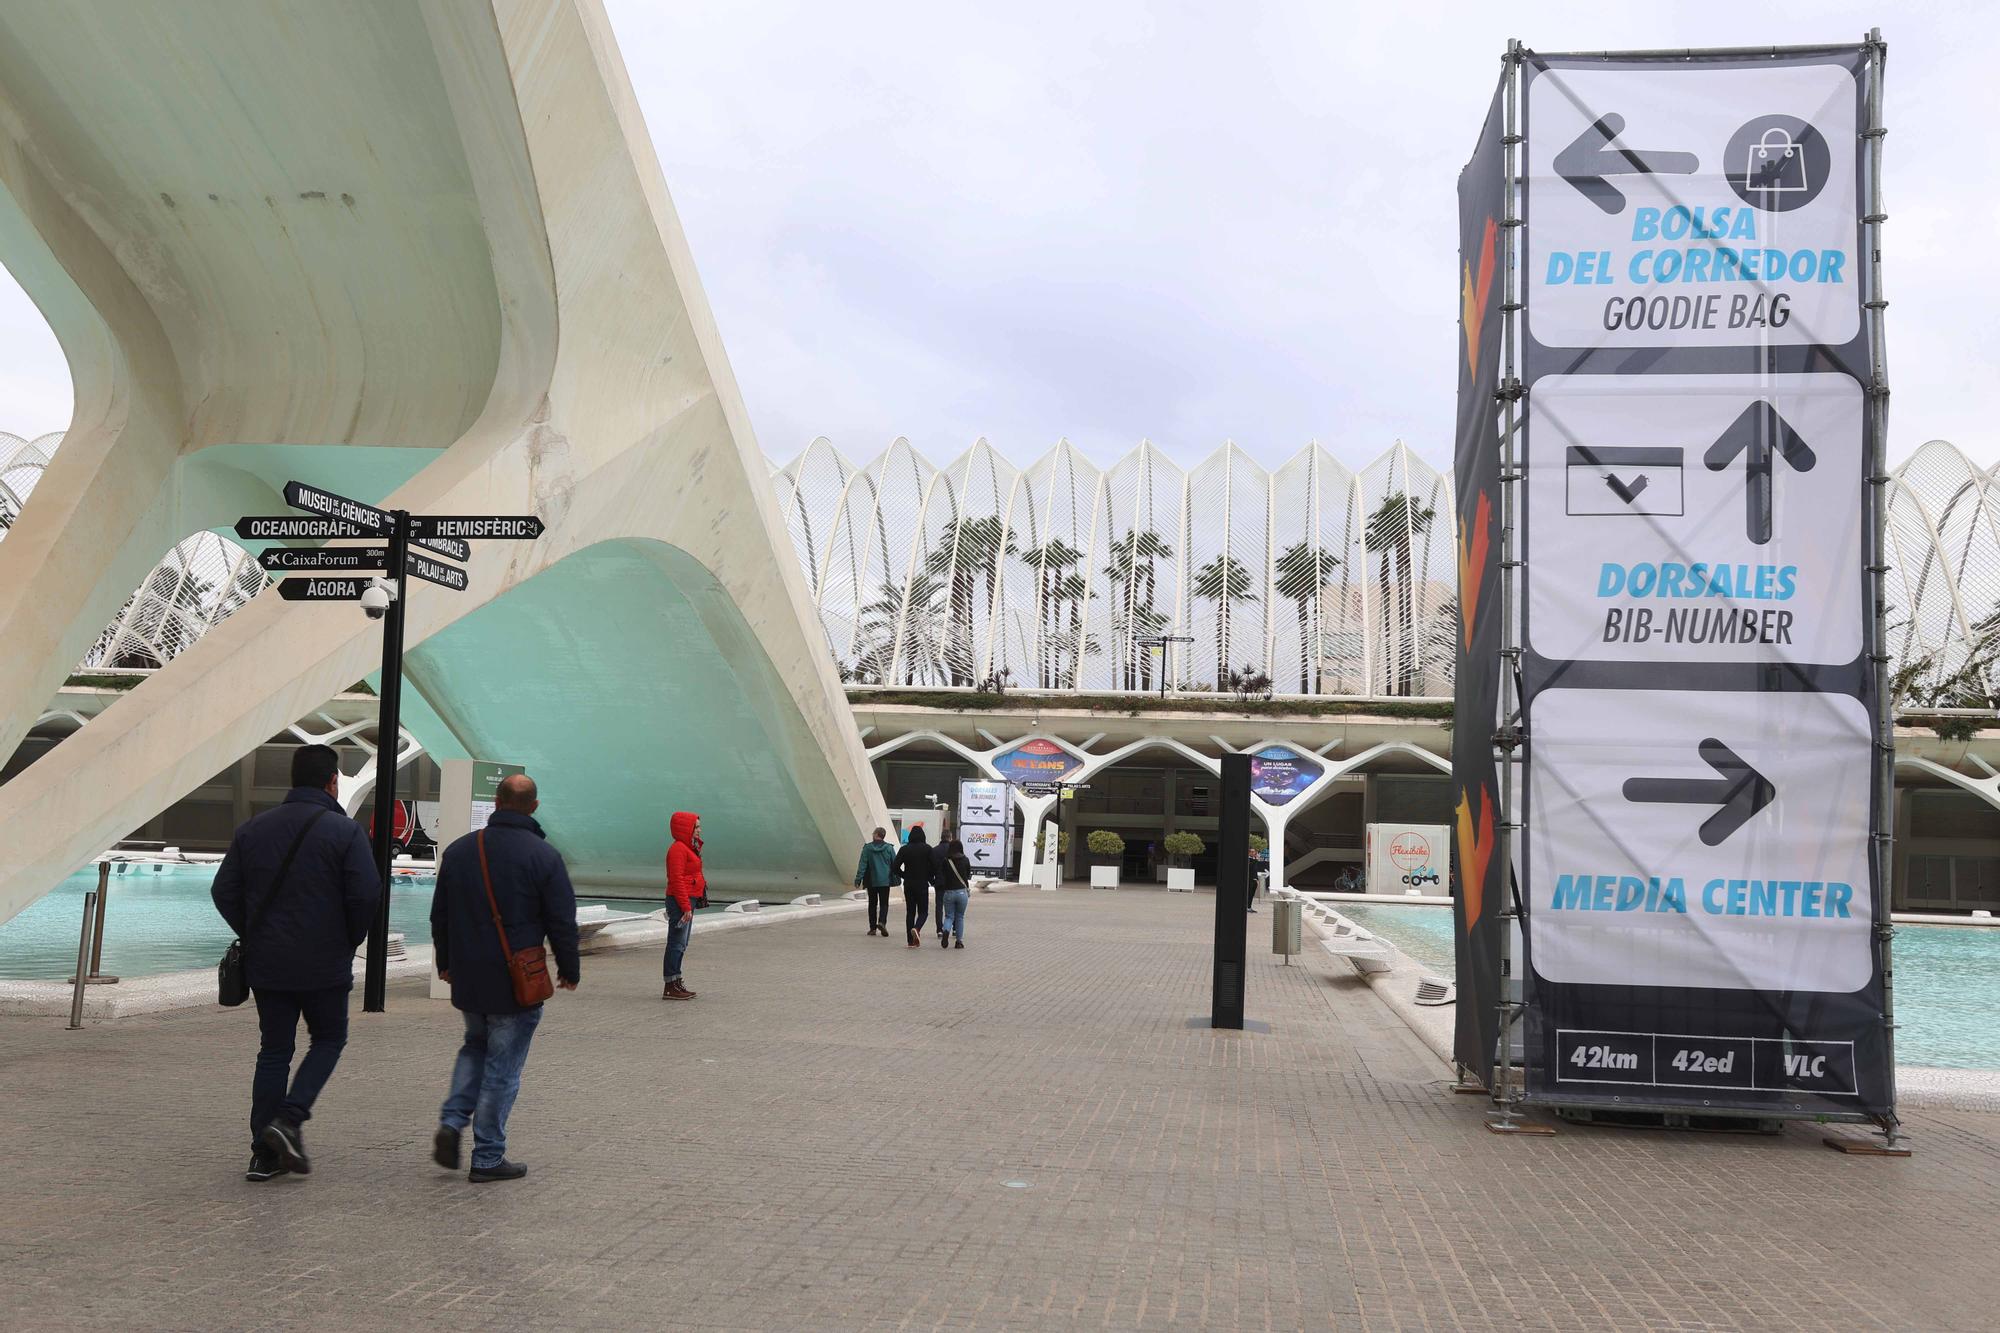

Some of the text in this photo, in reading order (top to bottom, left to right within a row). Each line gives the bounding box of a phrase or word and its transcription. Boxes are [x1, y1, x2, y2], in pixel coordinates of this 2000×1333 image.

[1631, 206, 1756, 241] BOLSA
[1545, 249, 1846, 285] DEL CORREDOR
[1603, 293, 1791, 330] GOODIE BAG
[299, 488, 332, 513] MUSEU
[341, 502, 380, 528] CIÈNCIES
[437, 518, 526, 535] HEMISFÈRIC
[282, 549, 384, 565] CaixaForum 300m
[306, 578, 357, 596] ÀGORA
[417, 560, 439, 579] PALAU
[446, 569, 463, 587] ARTS
[1597, 563, 1798, 600] DORSALES
[1602, 608, 1793, 645] BIB-NUMBER
[1551, 875, 1854, 919] MEDIA CENTER
[1570, 1045, 1638, 1070] 42km
[1672, 1049, 1735, 1074] 42ed
[1783, 1054, 1826, 1078] VLC
